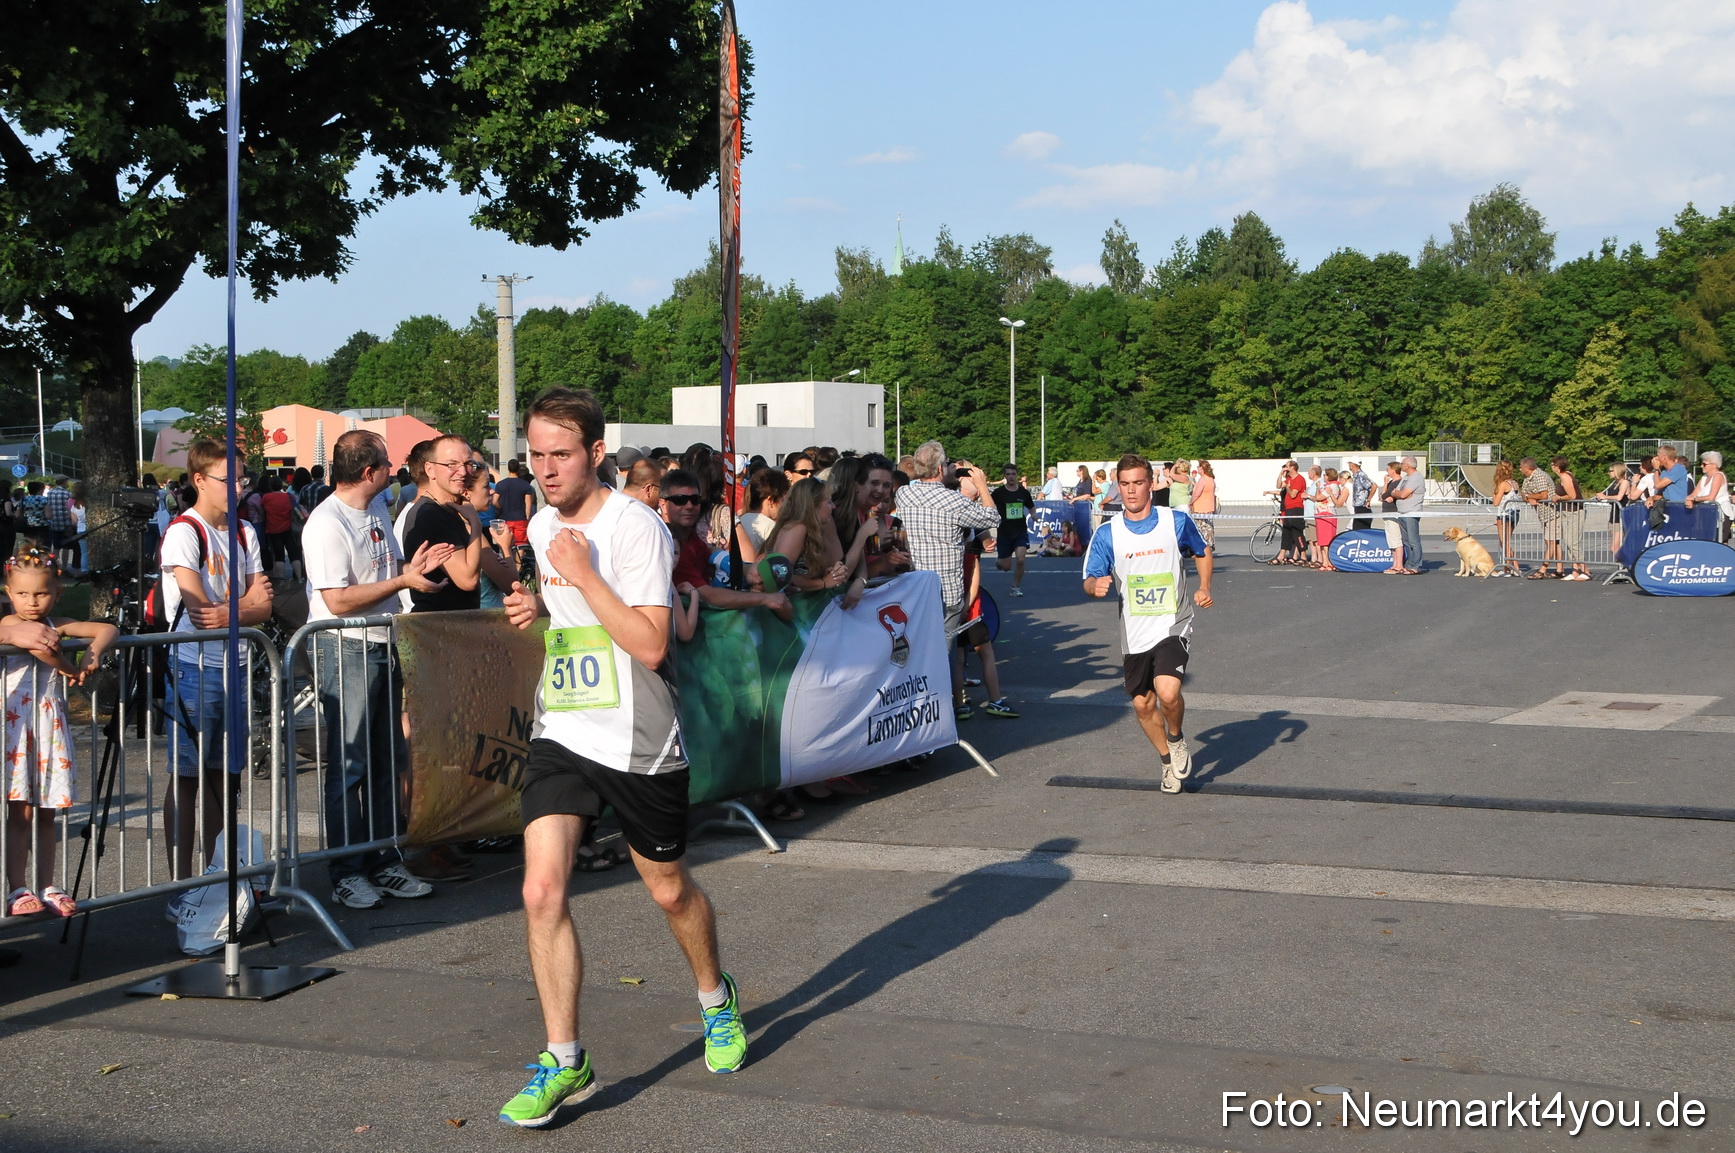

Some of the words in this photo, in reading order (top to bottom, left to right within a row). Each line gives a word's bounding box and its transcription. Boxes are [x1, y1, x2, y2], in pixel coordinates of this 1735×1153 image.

[1010, 508, 1019, 516] 81
[1645, 530, 1696, 547] Fisch
[1135, 548, 1166, 557] KLEBL
[1347, 547, 1393, 558] Fische
[1662, 564, 1732, 577] Fischer
[1135, 587, 1167, 605] 547
[552, 655, 600, 690] 510
[876, 675, 928, 708] Neumarkter
[867, 695, 940, 746] Lammsbräu
